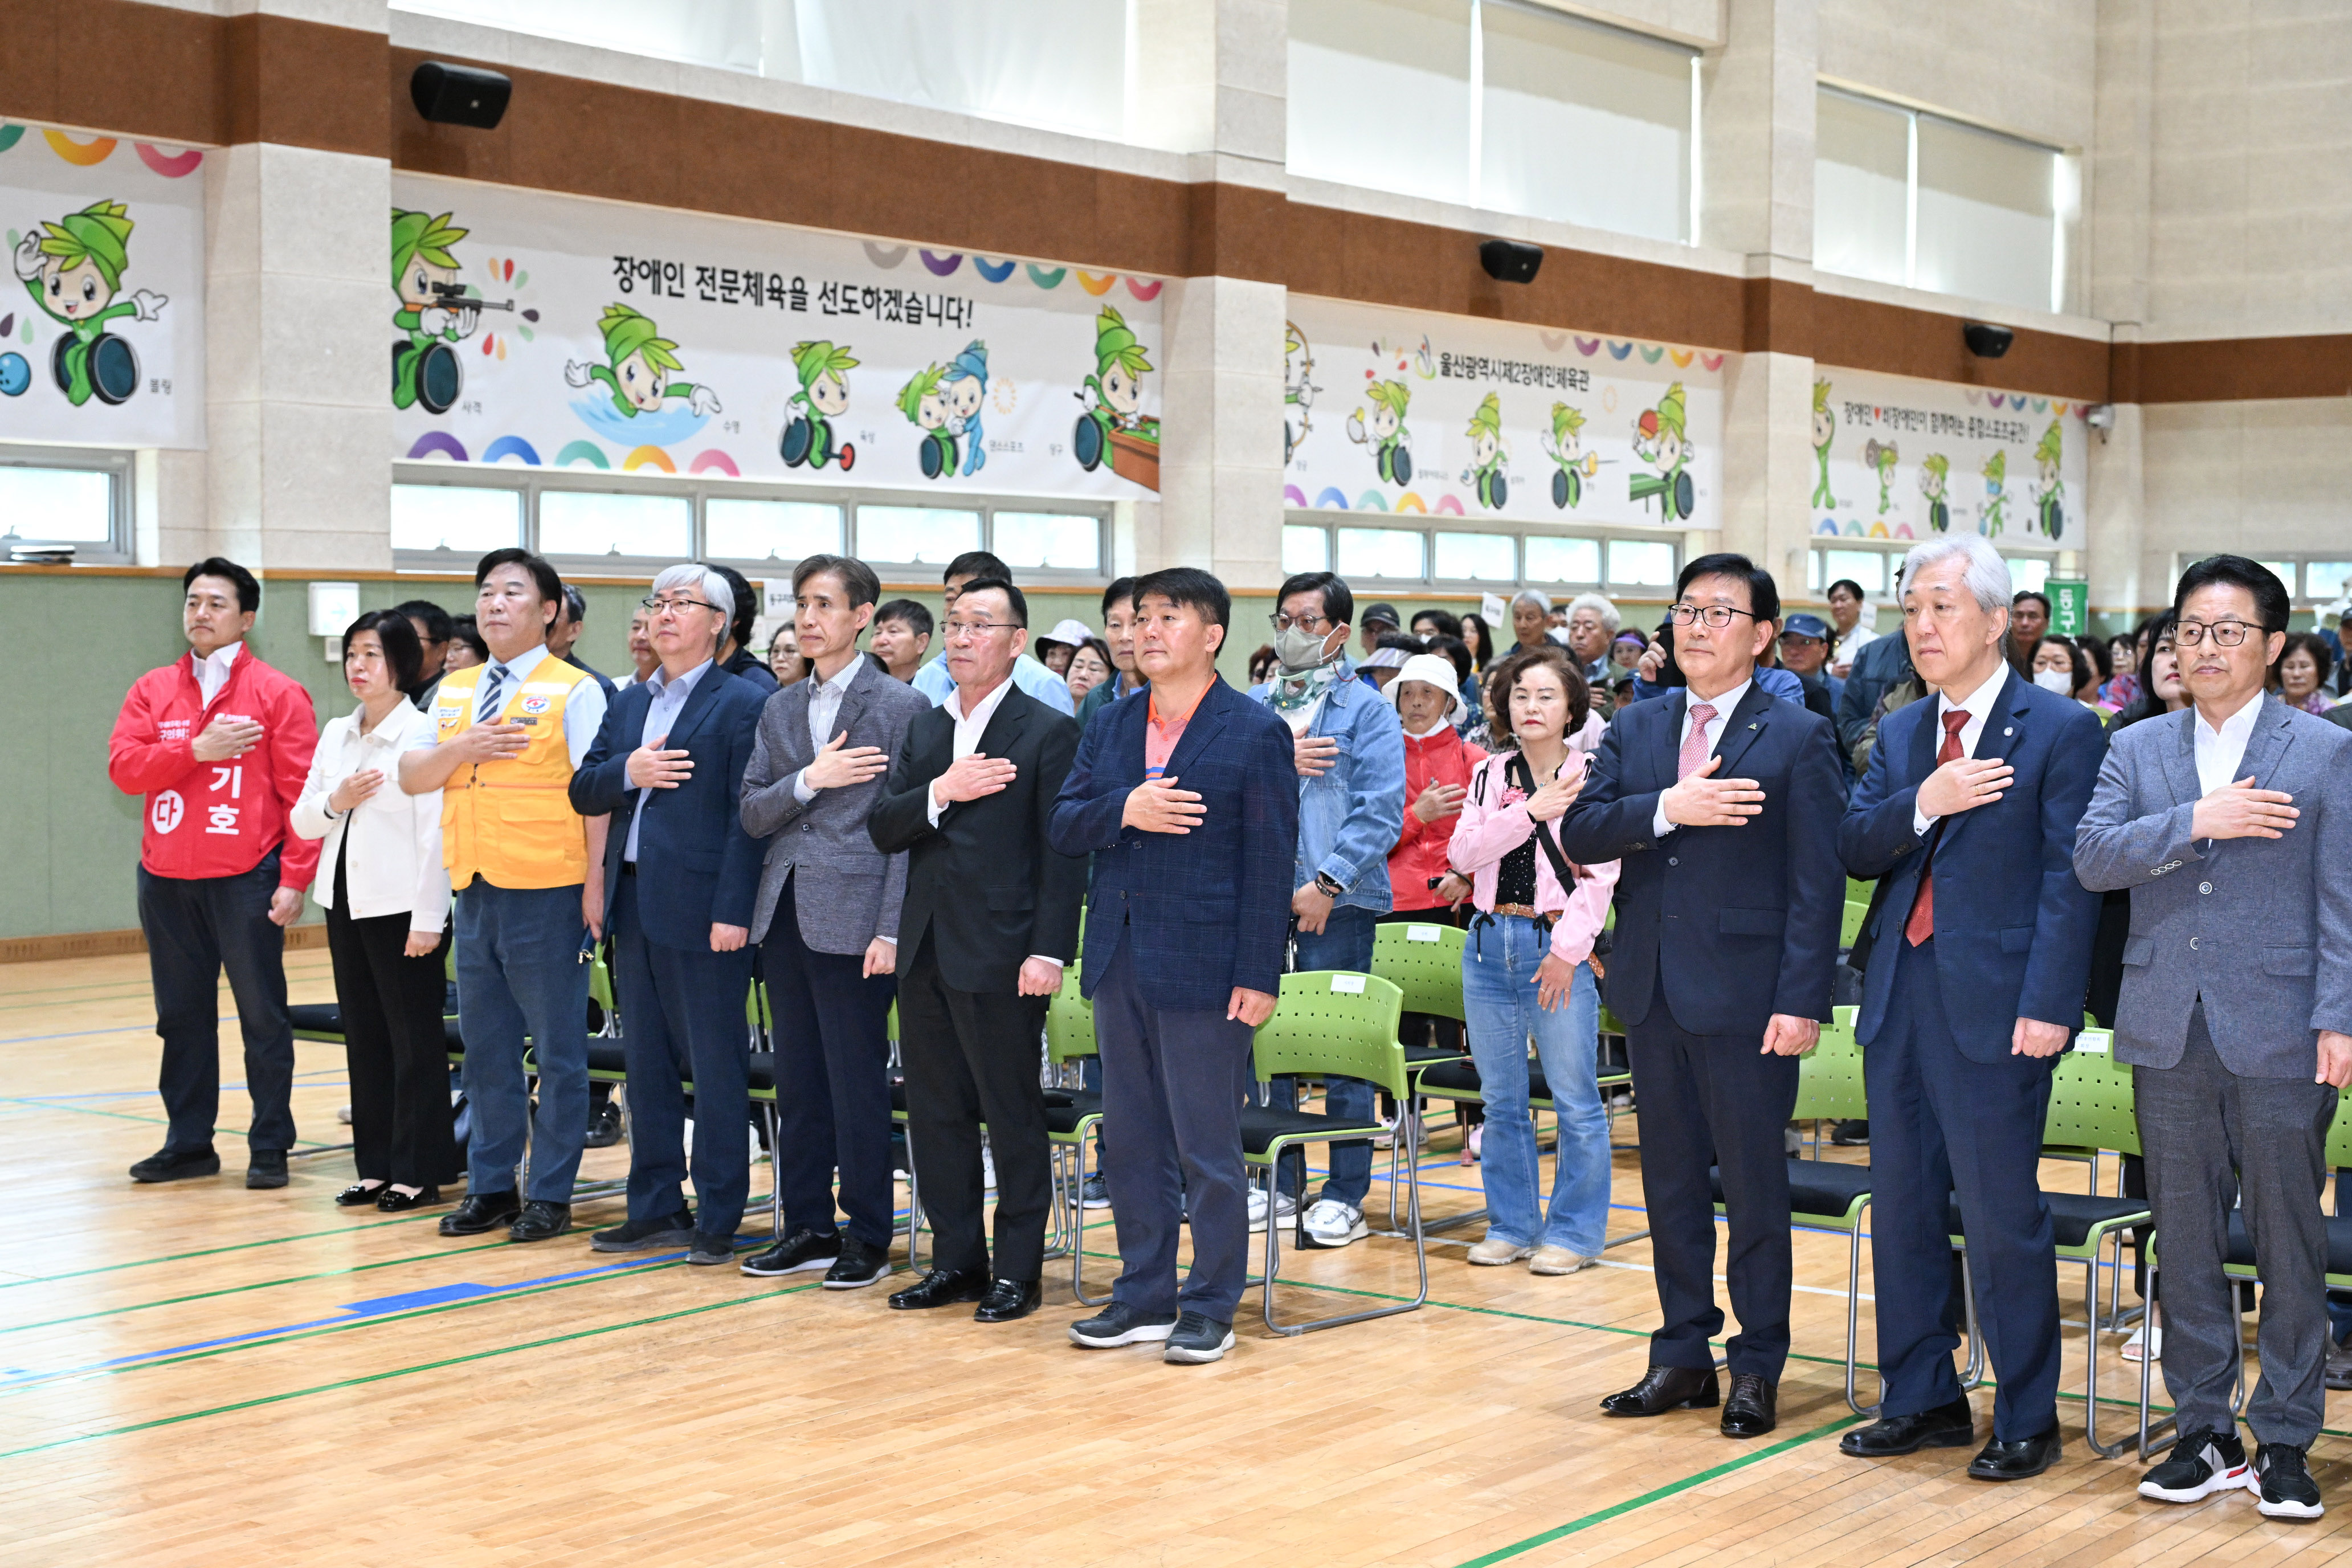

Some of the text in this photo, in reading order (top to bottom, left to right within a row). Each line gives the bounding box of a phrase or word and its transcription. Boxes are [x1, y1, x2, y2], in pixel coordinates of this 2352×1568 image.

[613, 255, 973, 329] 장애인 전문체육을 선도하겠습니다!
[206, 754, 243, 835] 기호
